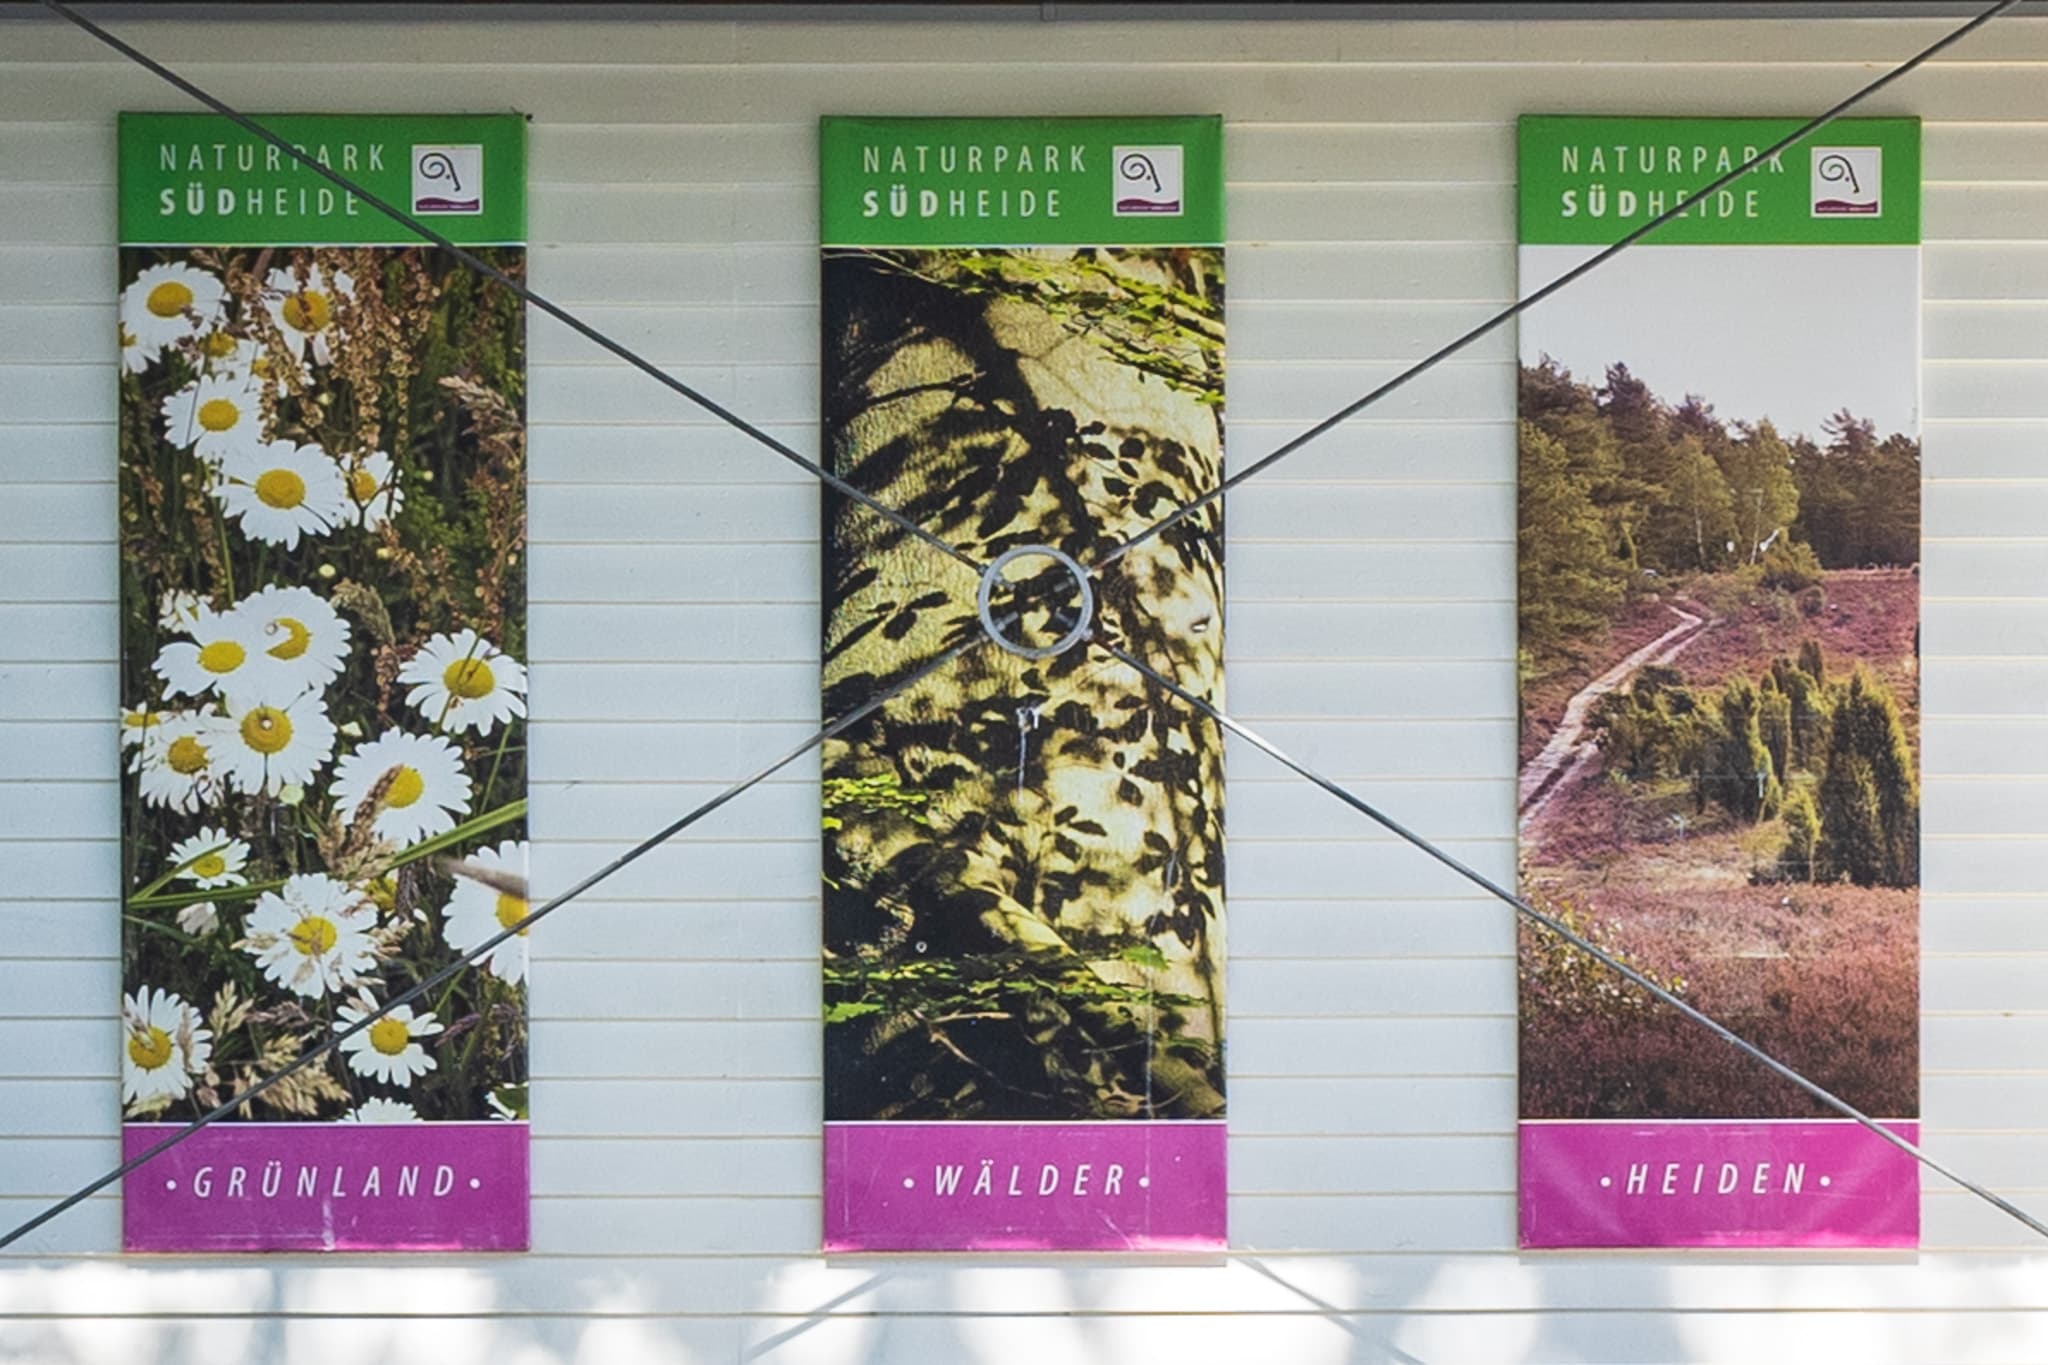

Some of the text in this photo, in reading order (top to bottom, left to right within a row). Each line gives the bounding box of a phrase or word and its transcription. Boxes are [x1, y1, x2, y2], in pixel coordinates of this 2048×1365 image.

[160, 144, 384, 171] NATURPARK
[864, 145, 1087, 173] NATURPARK
[1562, 146, 1784, 173] NATURPARK
[160, 181, 359, 216] SÜDHEIDE
[863, 184, 1060, 218] SÜDHEIDE
[1561, 183, 1758, 217] SÜDHEIDE
[193, 1160, 456, 1198] GRÜNLAND
[934, 1159, 1124, 1196] WÄLDER
[1626, 1162, 1807, 1195] HEIDEN
